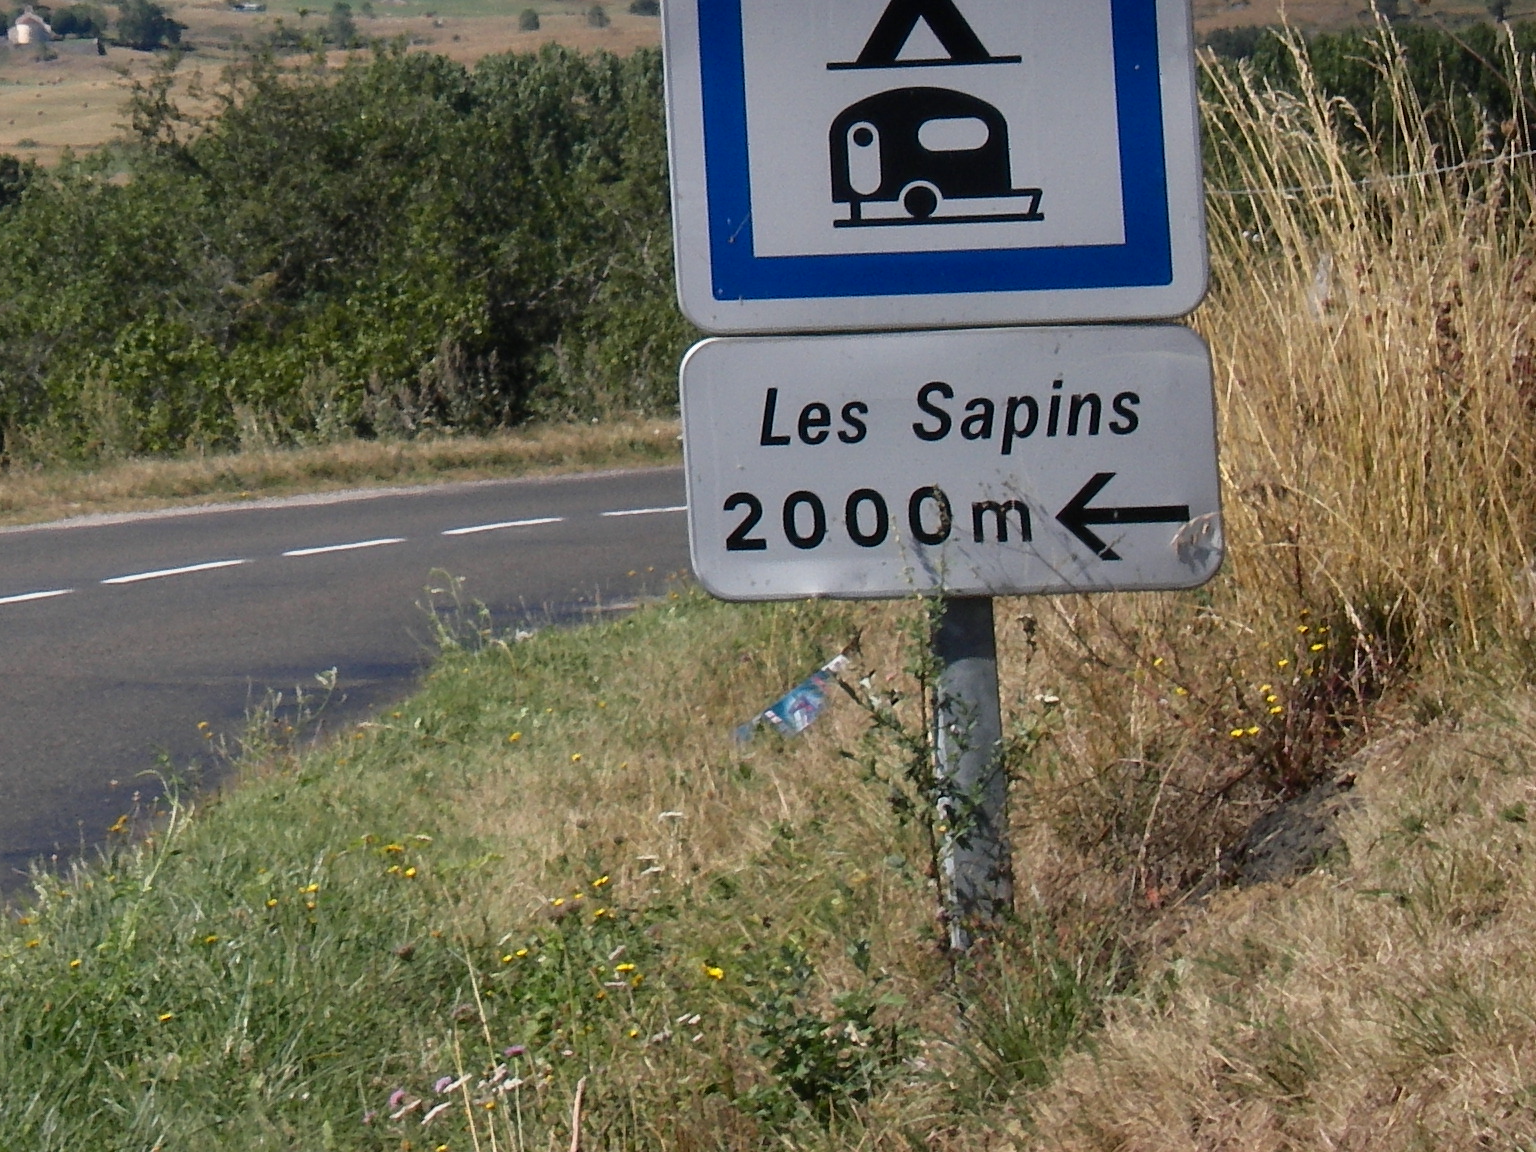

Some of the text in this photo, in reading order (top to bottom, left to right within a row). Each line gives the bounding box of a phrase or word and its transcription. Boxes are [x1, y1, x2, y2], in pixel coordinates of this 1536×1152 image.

[760, 379, 1141, 455] Les Sapins
[722, 484, 1033, 551] 2000m
